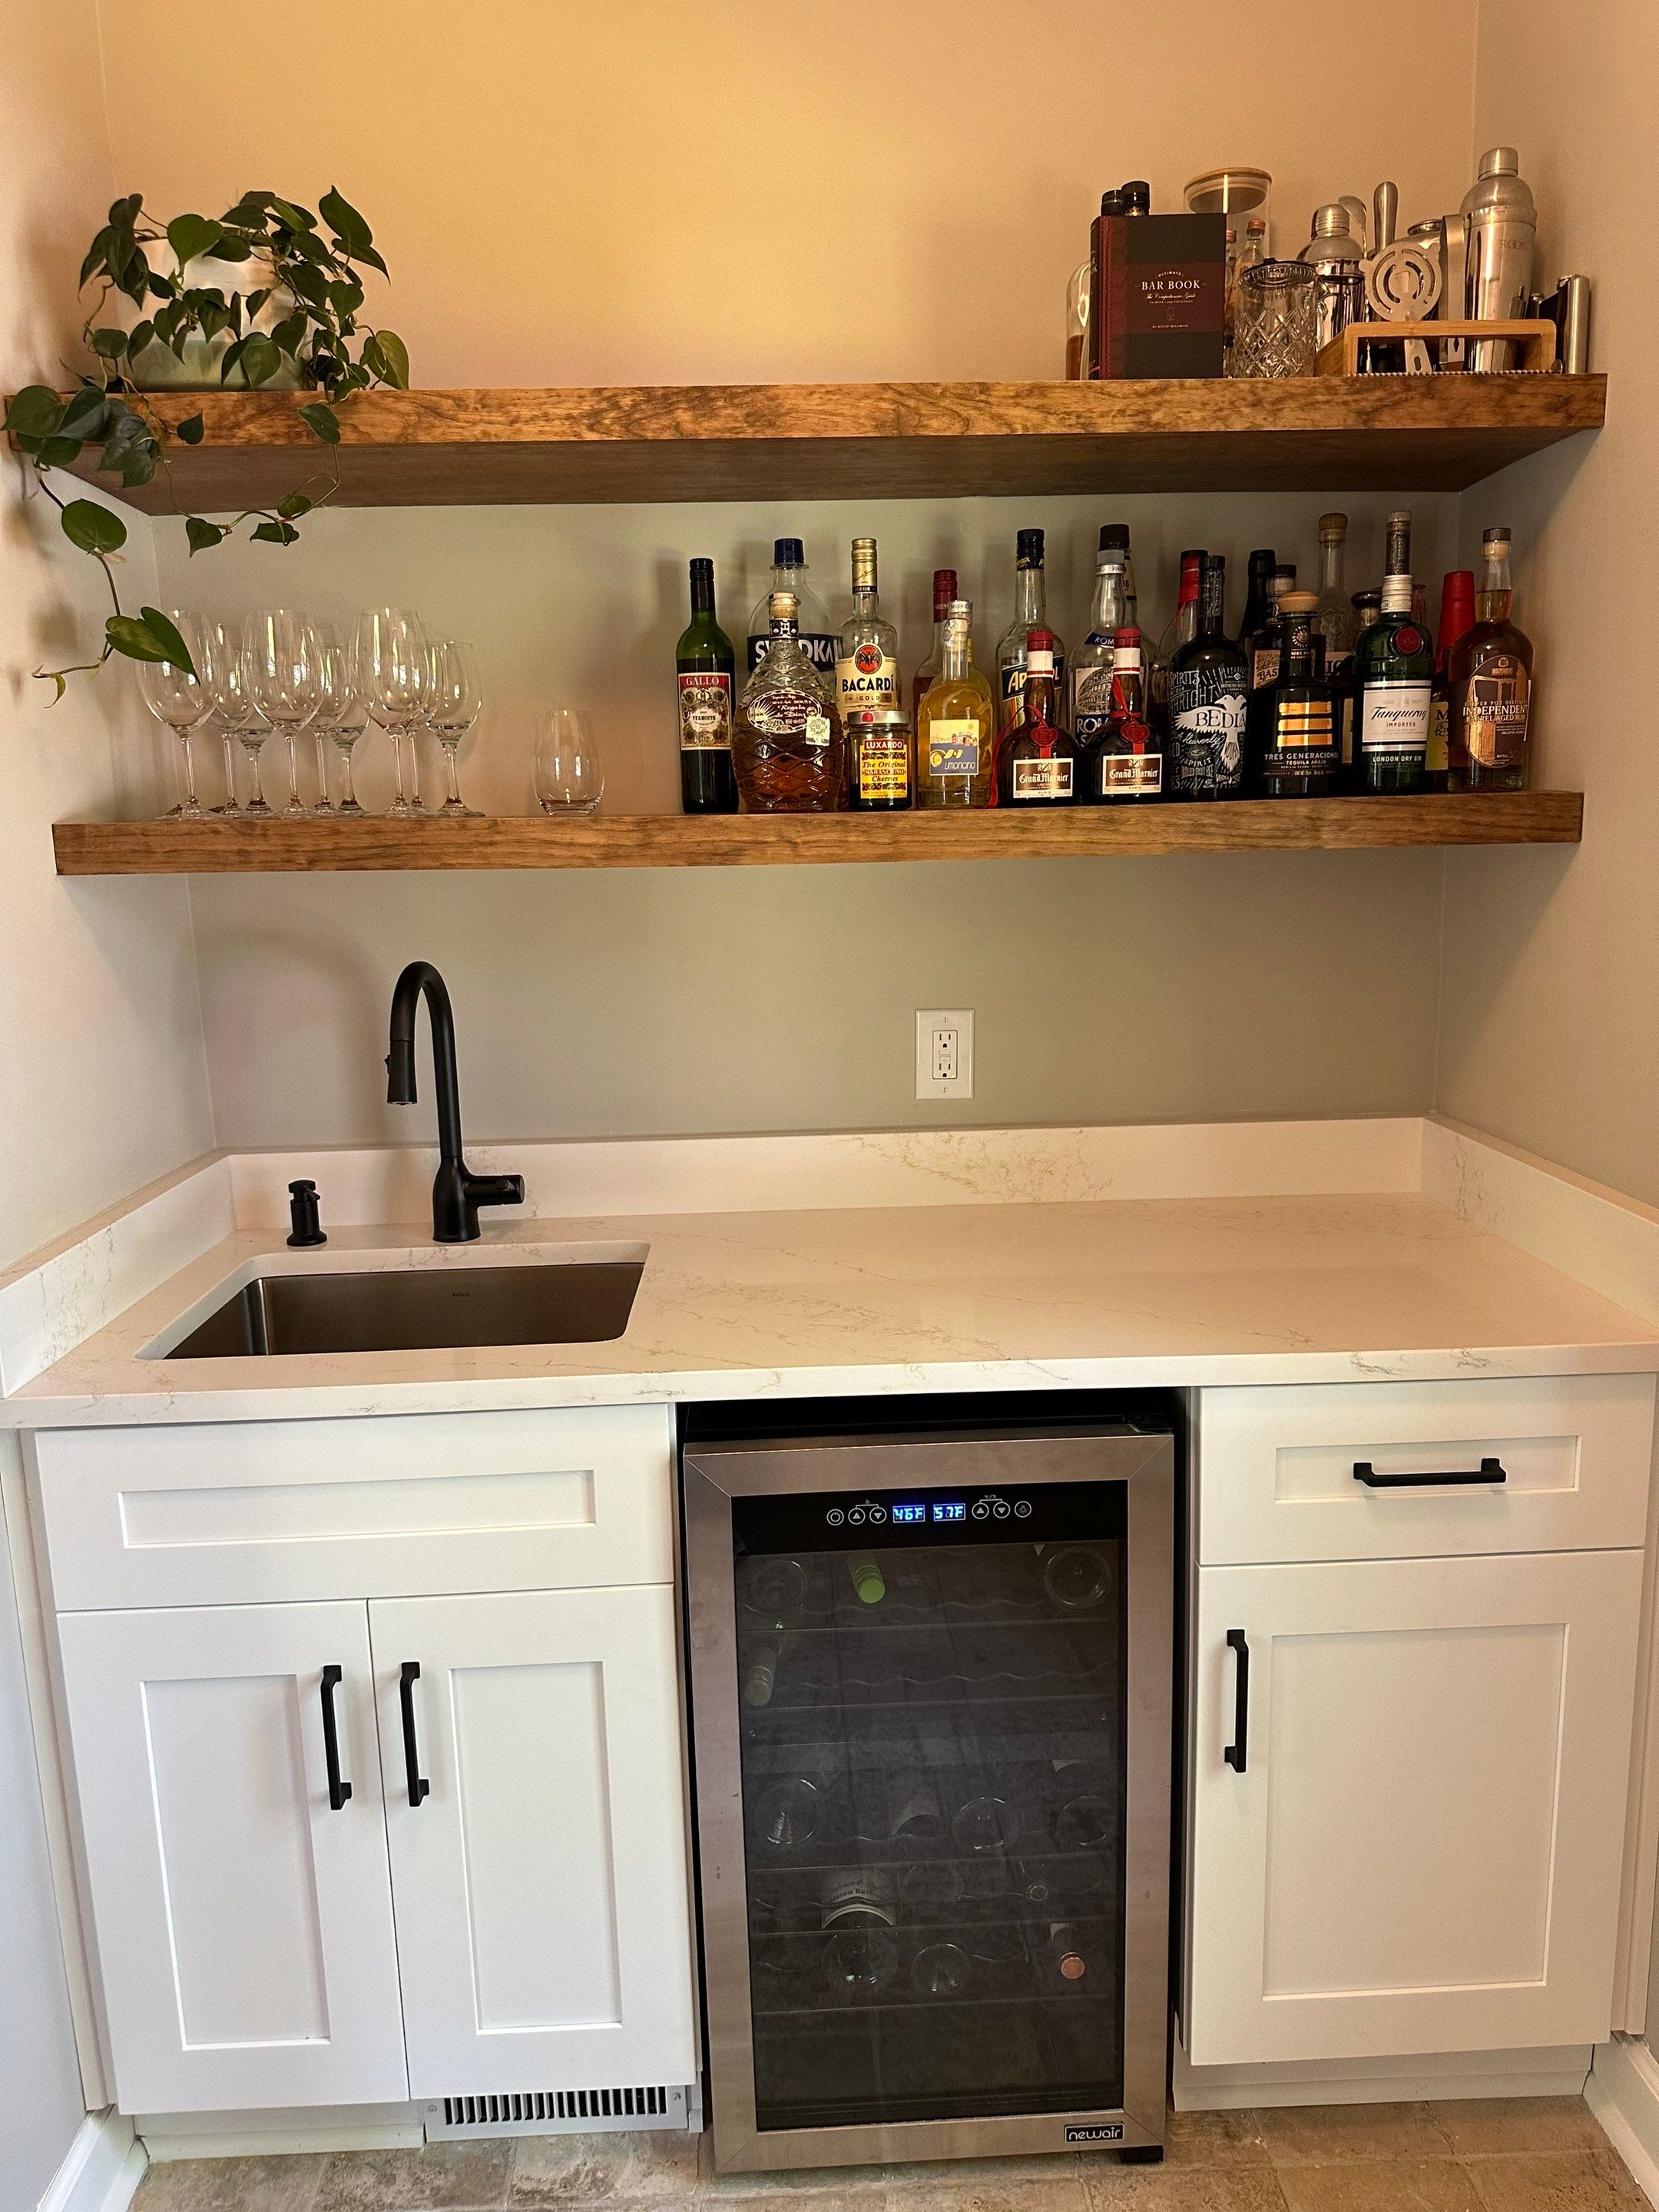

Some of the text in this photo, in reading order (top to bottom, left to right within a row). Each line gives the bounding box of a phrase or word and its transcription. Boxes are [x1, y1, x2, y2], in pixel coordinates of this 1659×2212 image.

[1141, 280, 1200, 290] BAR BOOK
[1094, 636, 1114, 645] ROM
[1008, 666, 1060, 693] APL
[1257, 667, 1278, 682] BAS
[686, 677, 720, 685] GALLO
[842, 674, 895, 692] BACARDÍ
[1370, 707, 1428, 721] Tanqueray
[866, 741, 902, 750] LUXARDO
[1184, 757, 1211, 767] SPIRIT
[1109, 768, 1158, 779] Grand Marnier
[893, 1505, 964, 1521] 46F 57F
[1068, 2126, 1121, 2141] newair
